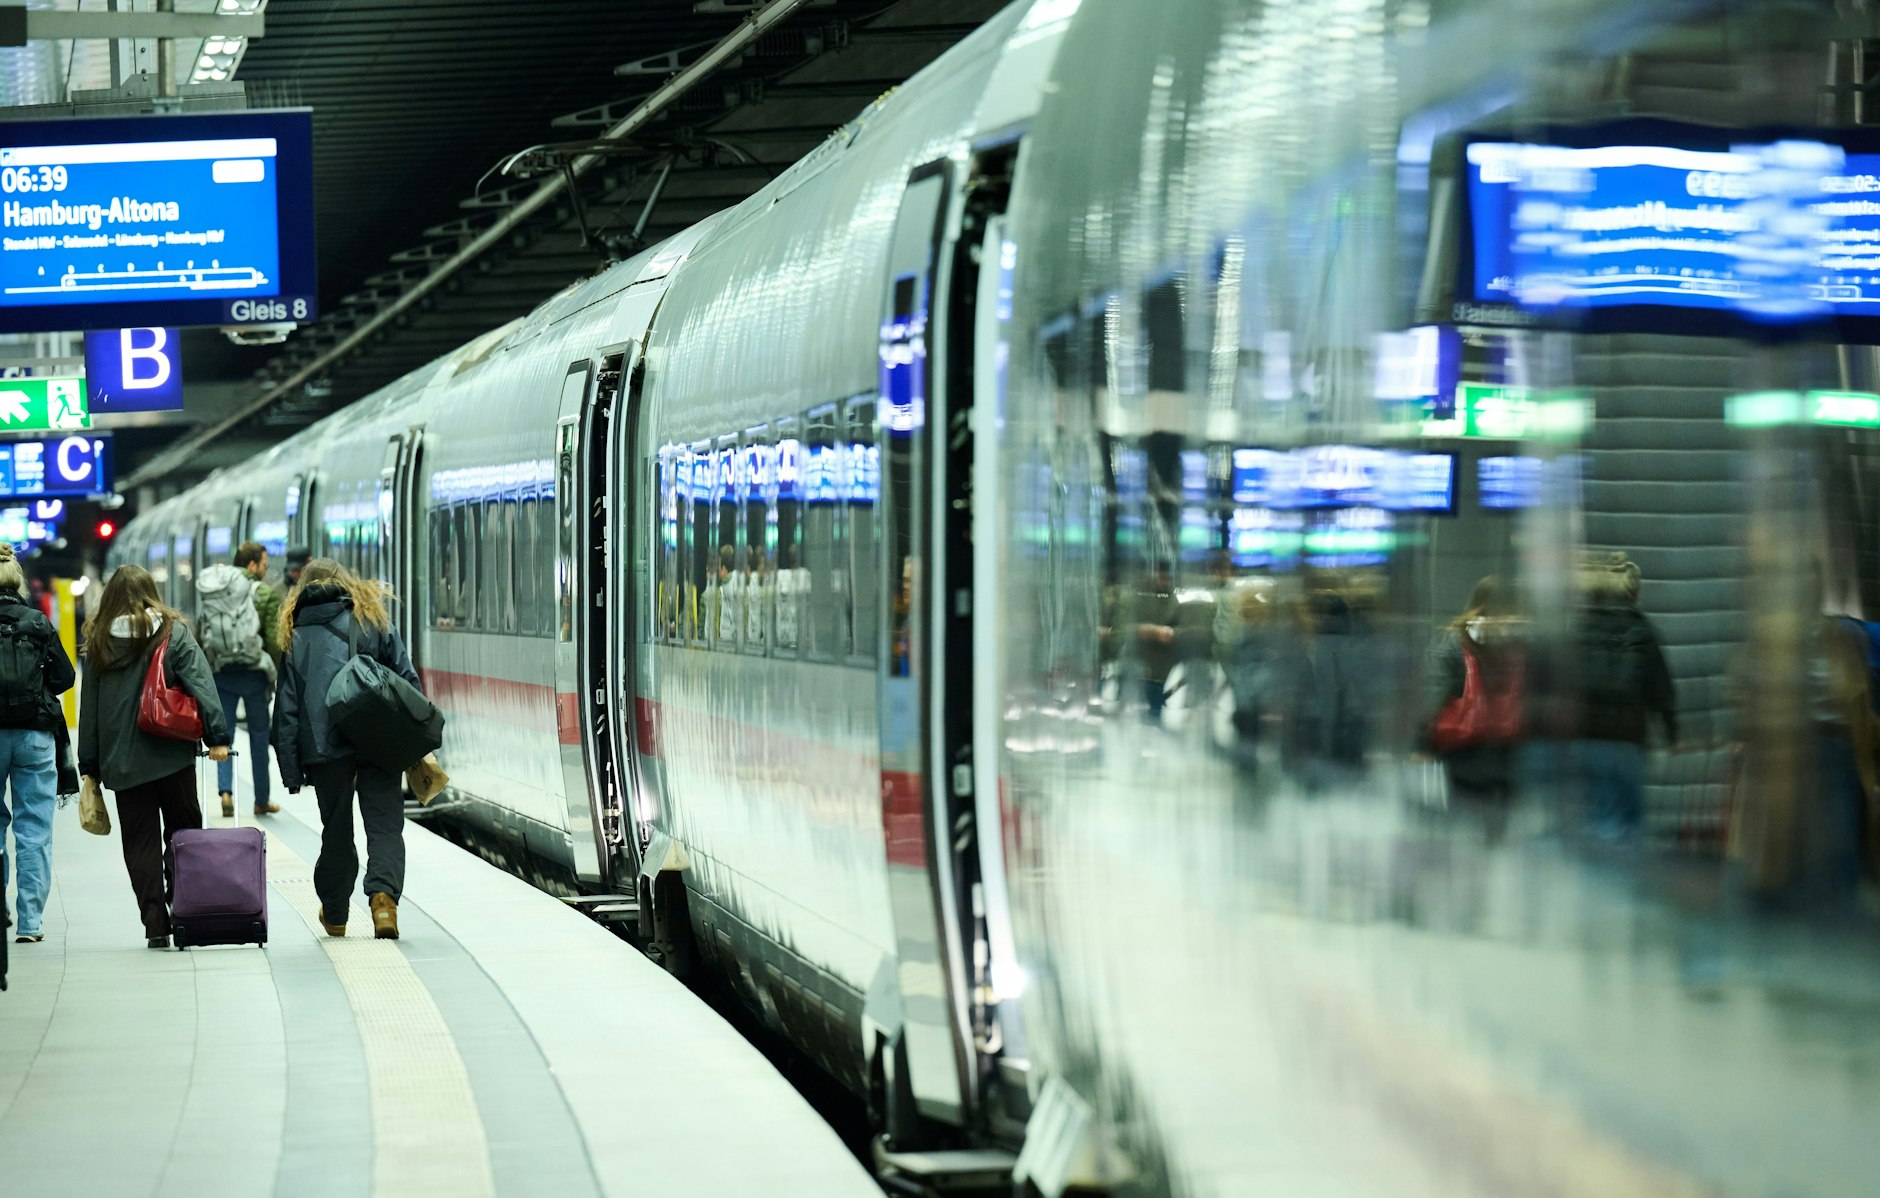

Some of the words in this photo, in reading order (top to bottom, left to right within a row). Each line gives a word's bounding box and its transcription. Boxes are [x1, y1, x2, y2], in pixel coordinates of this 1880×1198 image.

[1, 166, 68, 193] 06:39
[3, 196, 180, 230] Hamburg-Altona
[230, 299, 288, 321] Gleis
[292, 298, 308, 319] 8
[120, 326, 171, 390] B
[57, 436, 92, 481] C
